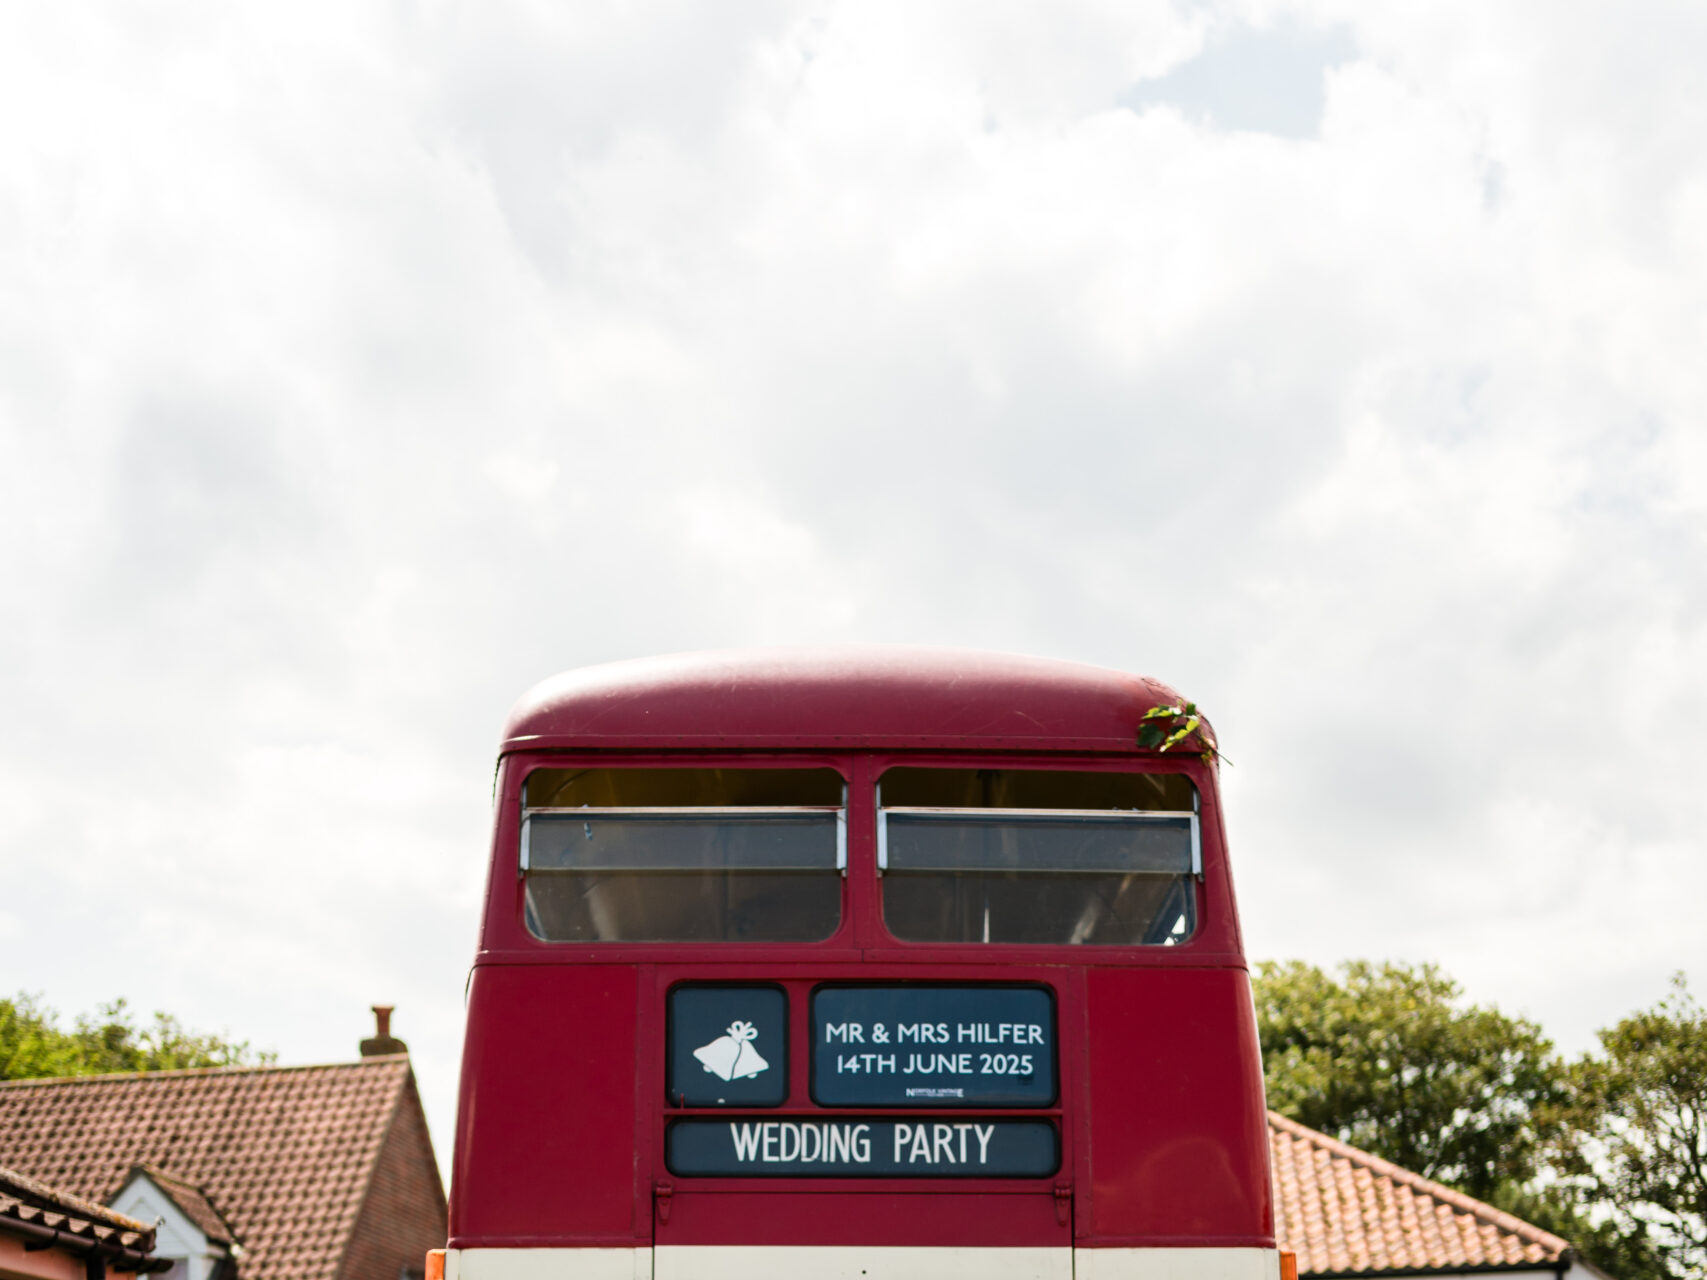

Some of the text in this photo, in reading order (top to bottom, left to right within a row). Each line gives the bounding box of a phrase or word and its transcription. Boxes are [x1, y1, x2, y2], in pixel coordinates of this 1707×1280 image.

[825, 1022, 1045, 1045] MR & MRS HILFER
[837, 1053, 1034, 1075] 14TH JUNE 2025
[730, 1122, 995, 1164] WEDDING PARTY
